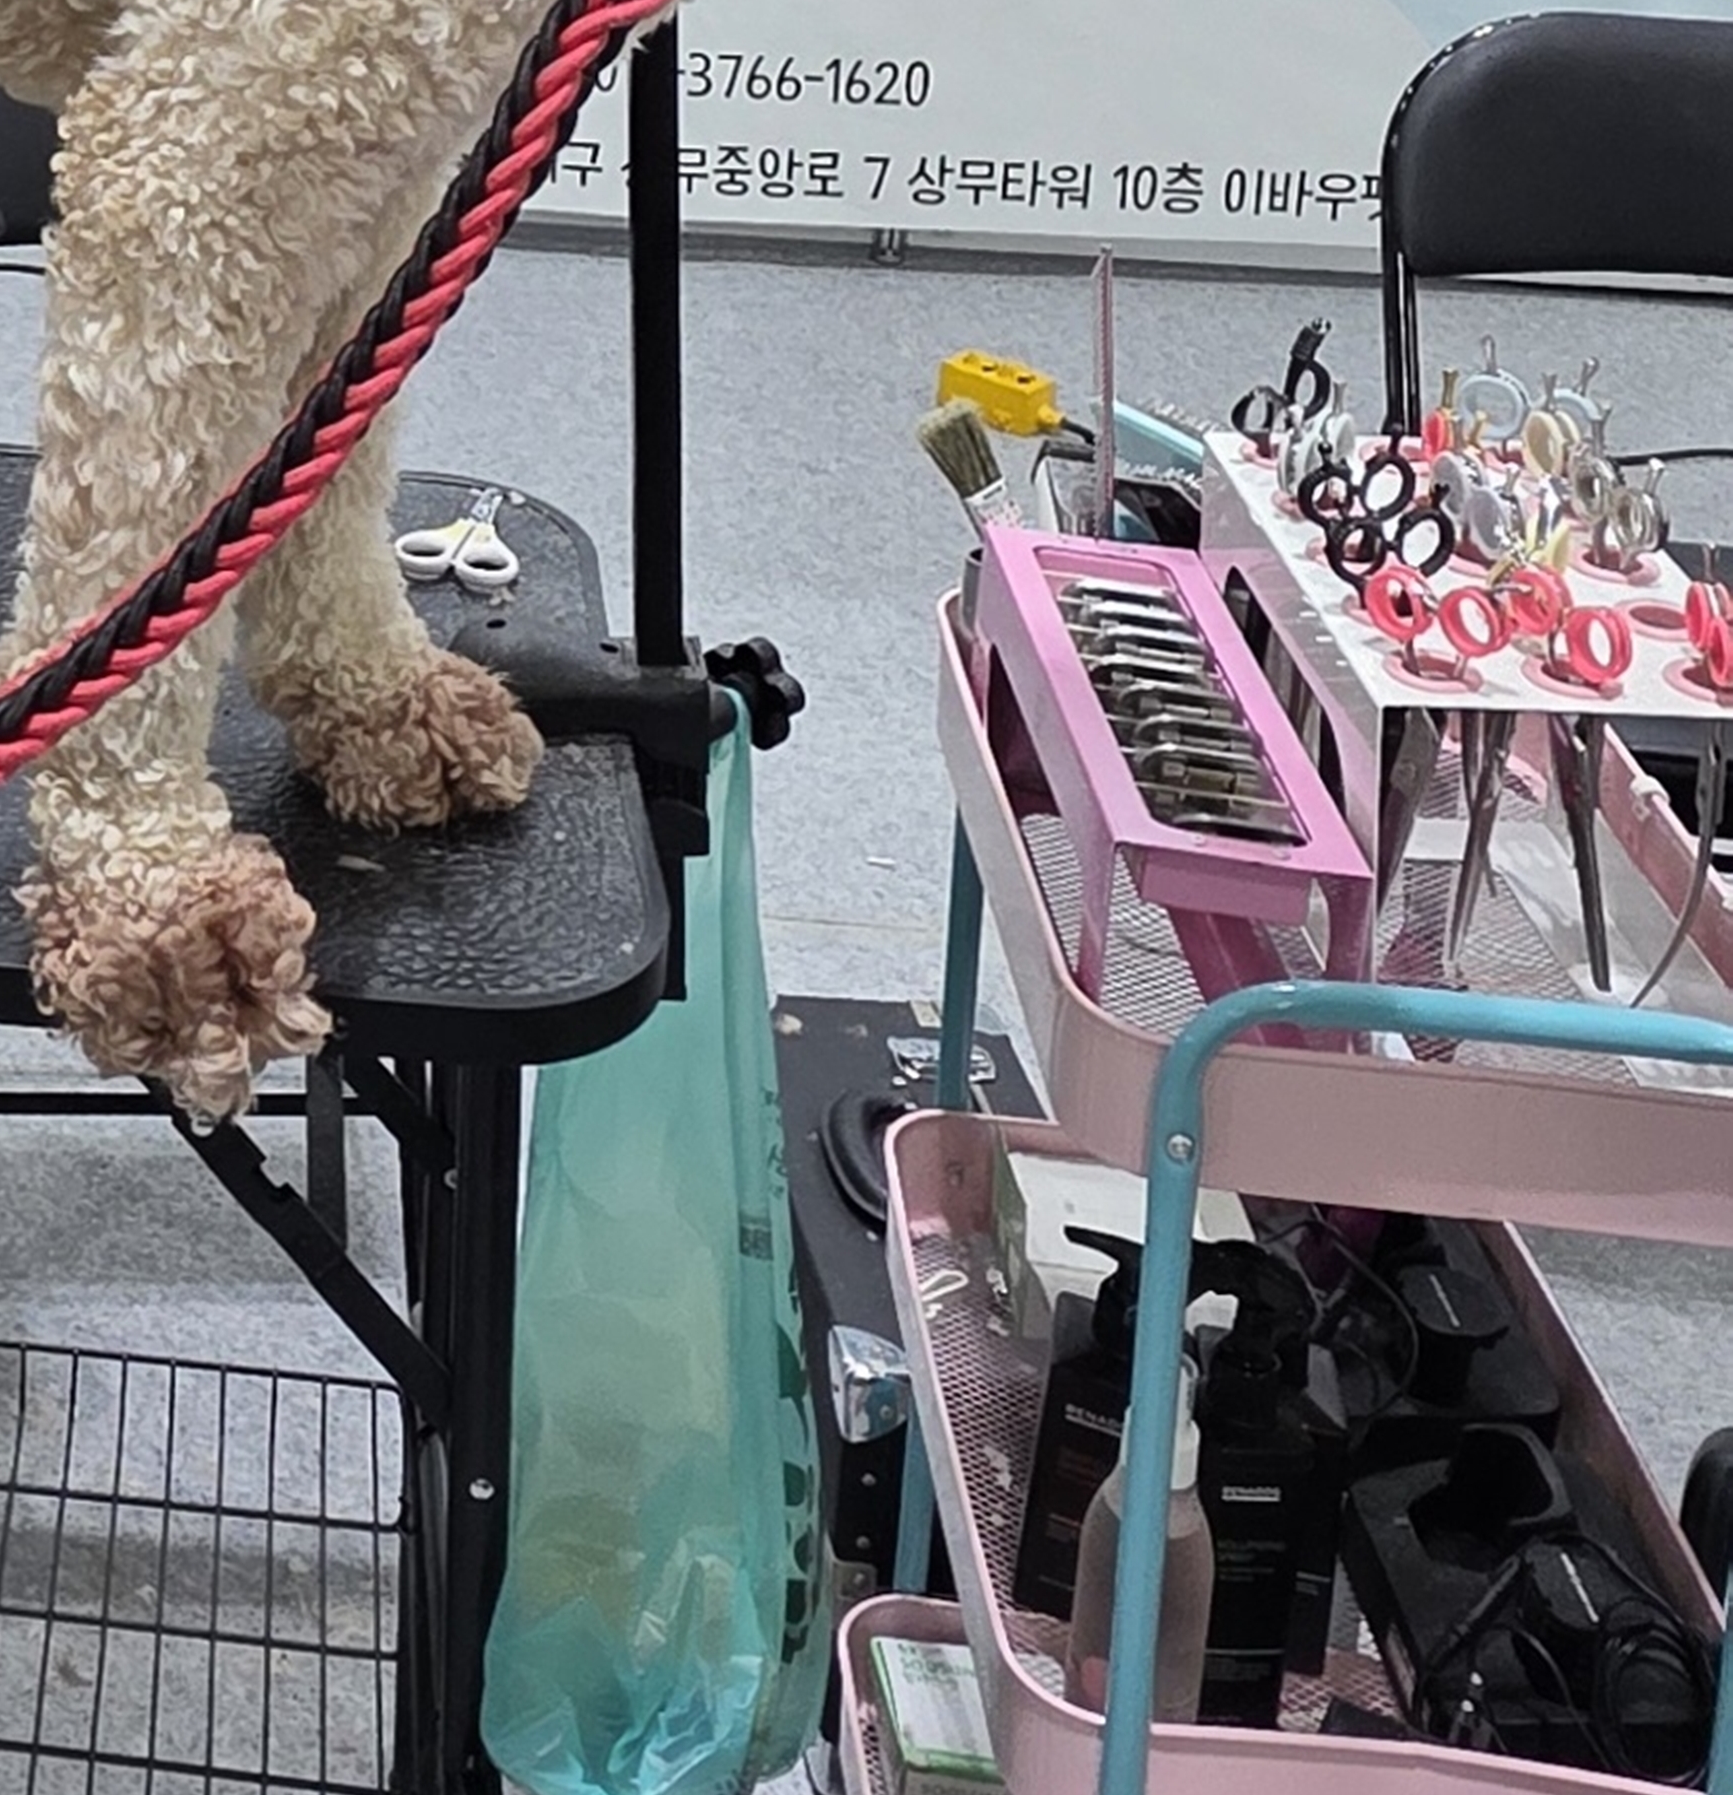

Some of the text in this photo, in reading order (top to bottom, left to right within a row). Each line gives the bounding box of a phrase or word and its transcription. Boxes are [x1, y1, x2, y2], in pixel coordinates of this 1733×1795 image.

[620, 144, 845, 200] 무중앙로
[862, 156, 891, 201] 7
[907, 154, 1092, 210] 상무타워
[1112, 161, 1204, 215] 10층
